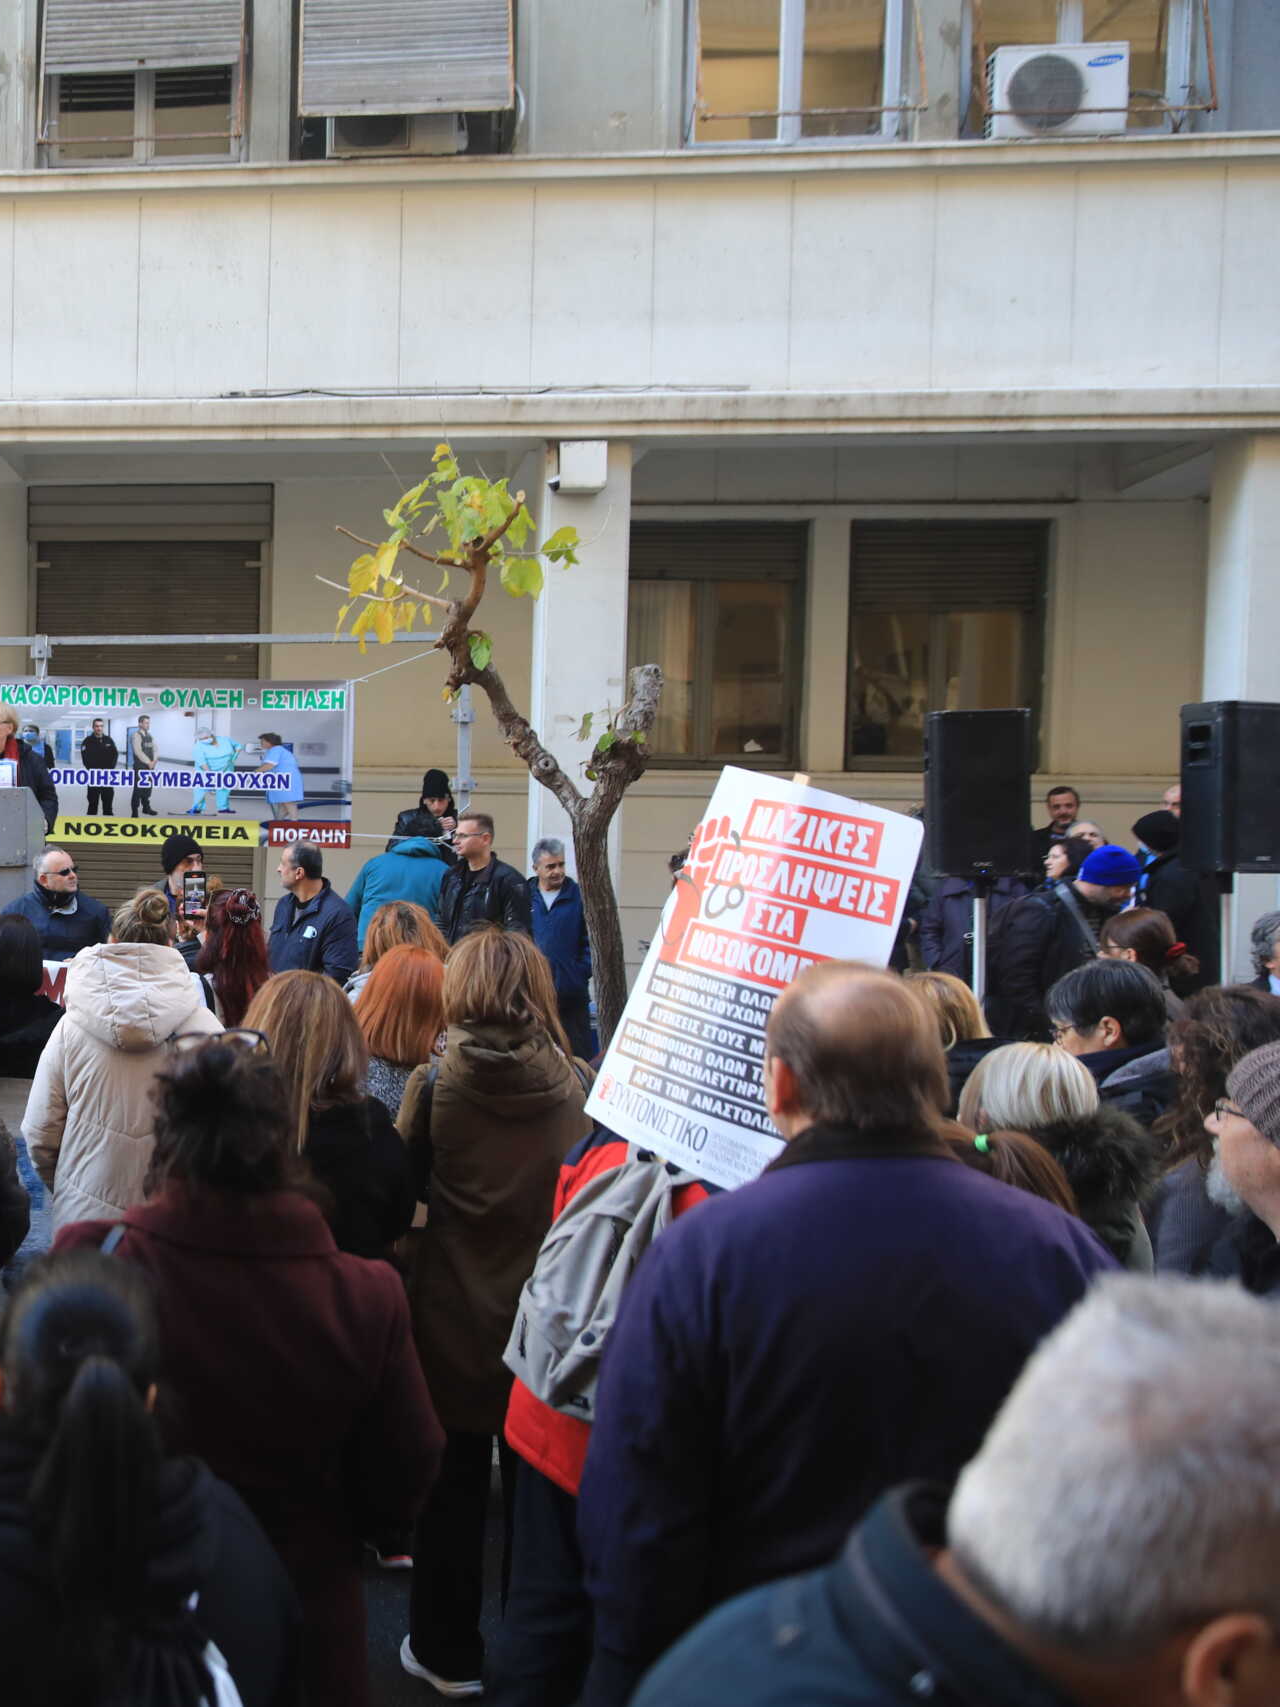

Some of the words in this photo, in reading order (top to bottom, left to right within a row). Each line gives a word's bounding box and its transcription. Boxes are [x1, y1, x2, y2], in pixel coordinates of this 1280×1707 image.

[0, 685, 142, 708] ΚΑΘΑΡΙΟΤΗΤΑ
[159, 688, 243, 709] ΦΥΛΑΞΗ
[262, 689, 345, 710] ΕΣΤΙΑΣΗ
[50, 769, 133, 786] ΟΠΟΙΗΣΗ
[138, 771, 290, 790] ΣΥΜΒΑΣΙΟΥΧΩΝ
[64, 822, 249, 841] ΝΟΣΟΚΟΜΕΙΑ
[273, 827, 347, 844] ΠΟΕΔΗΝ
[748, 806, 874, 860] ΜΑΖΙΚΕΣ
[715, 849, 890, 919] ΠΡΟΣΛΗΨΕΙΣ
[749, 900, 795, 938] ΣΤΑ
[701, 1023, 746, 1050] ΣΤΟΥΣ
[669, 1056, 766, 1101] ΝΟΣΗΛΕΥΤΗΡΙ
[705, 1052, 747, 1077] ΟΛΩΝ
[609, 1081, 709, 1152] ΣΥΝΤΟΝΙΣΤΙΚΟ
[632, 1070, 661, 1092] ΑΡΣΗ
[665, 1081, 690, 1102] ΤΩΝ
[691, 1094, 783, 1135] ΑΝΑΣΤΟΛΩ
